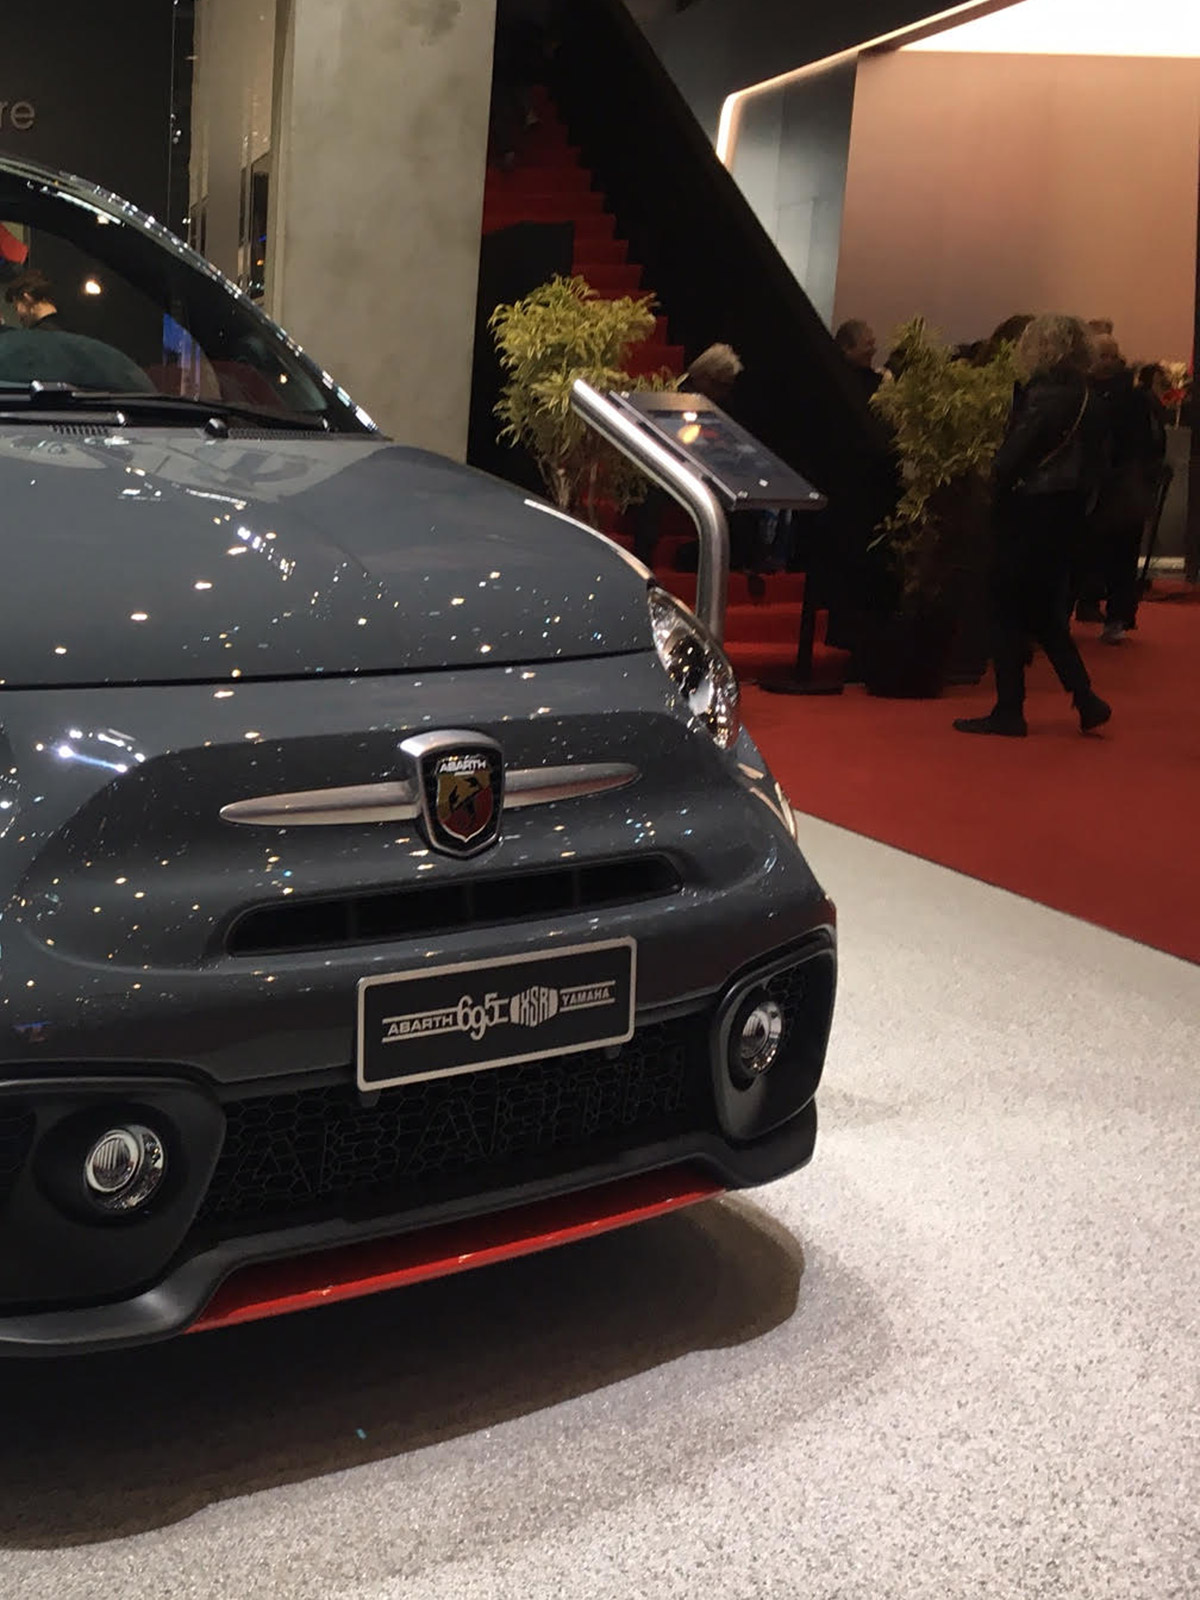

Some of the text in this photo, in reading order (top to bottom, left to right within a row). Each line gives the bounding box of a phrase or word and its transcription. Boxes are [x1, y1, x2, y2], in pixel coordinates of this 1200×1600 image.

[440, 759, 486, 773] ABARTH
[387, 1014, 453, 1036] ABARTH
[457, 992, 498, 1041] 695
[562, 988, 610, 1006] YAMAHA
